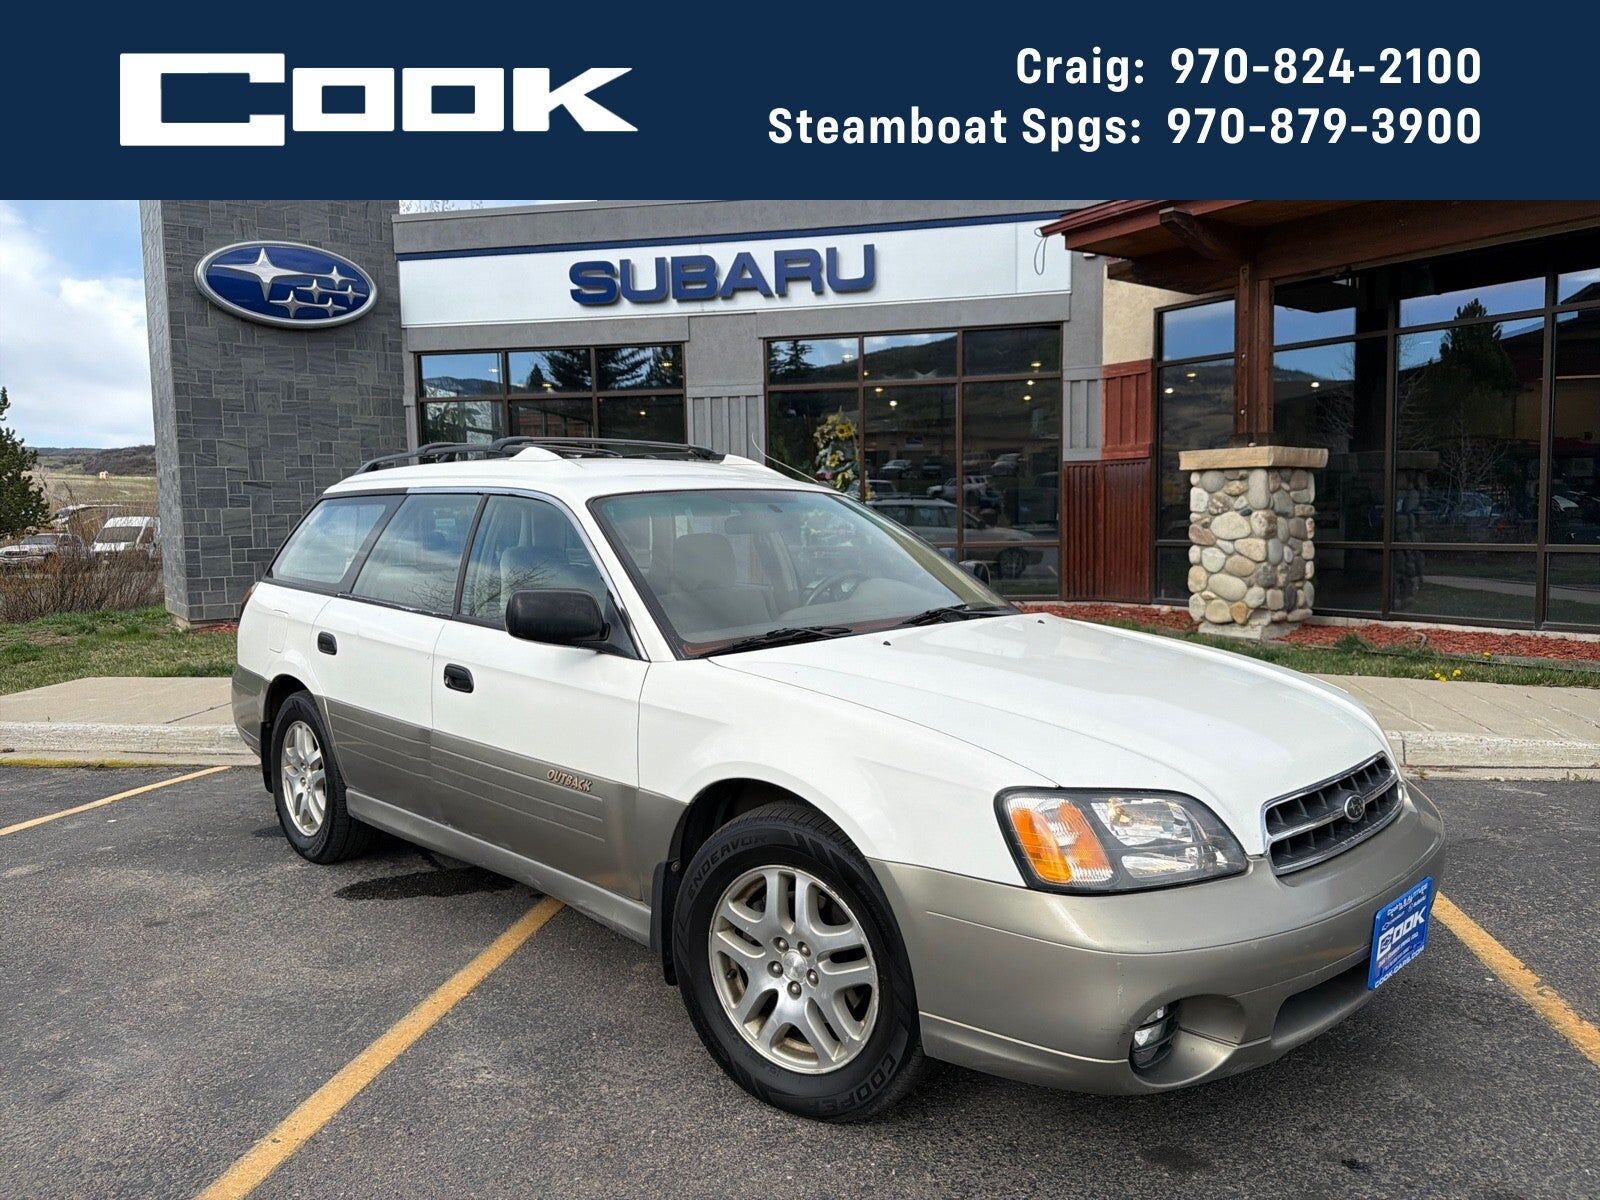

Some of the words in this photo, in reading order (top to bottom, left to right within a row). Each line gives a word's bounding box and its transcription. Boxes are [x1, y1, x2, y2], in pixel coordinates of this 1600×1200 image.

[569, 244, 876, 306] SUBARU
[547, 769, 593, 792] OUTBACK
[1376, 906, 1427, 961] COOK
